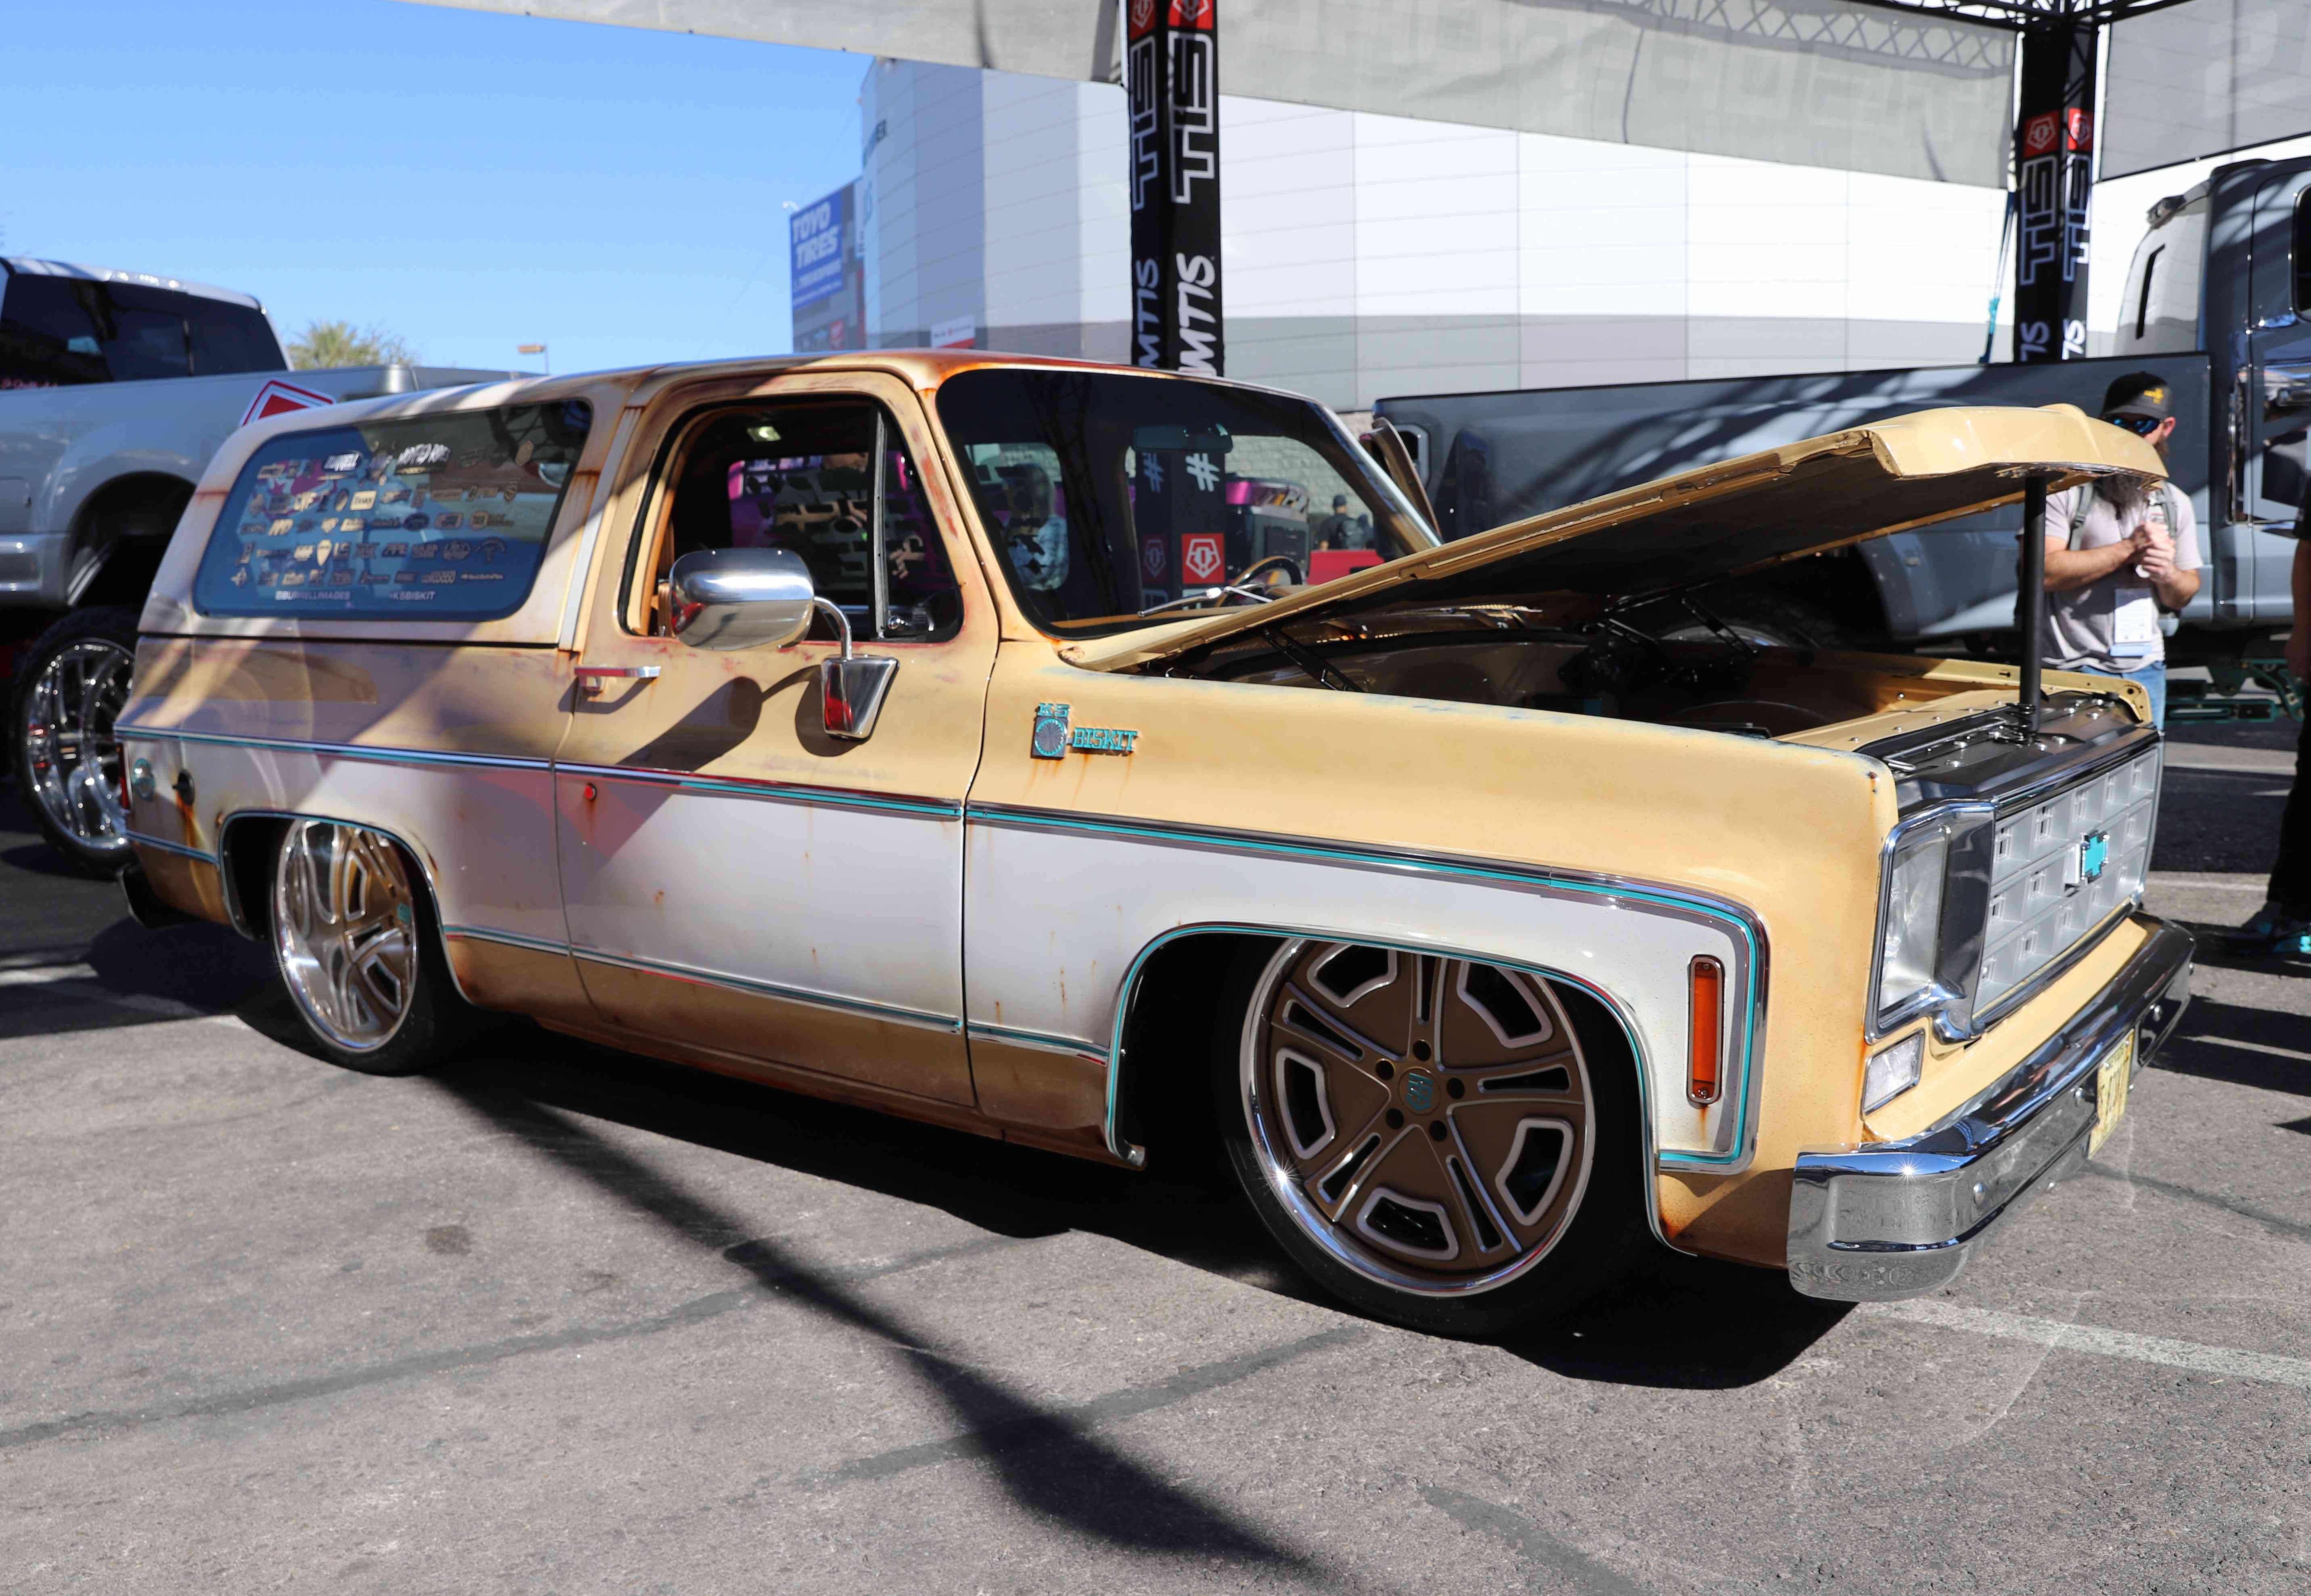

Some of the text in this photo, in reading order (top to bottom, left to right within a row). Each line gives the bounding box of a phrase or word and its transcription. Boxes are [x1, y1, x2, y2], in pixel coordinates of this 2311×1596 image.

[1168, 30, 1215, 204] TIS
[792, 201, 831, 245] TOYO
[796, 225, 839, 269] TIRES
[1072, 727, 1137, 752] BISKIT
